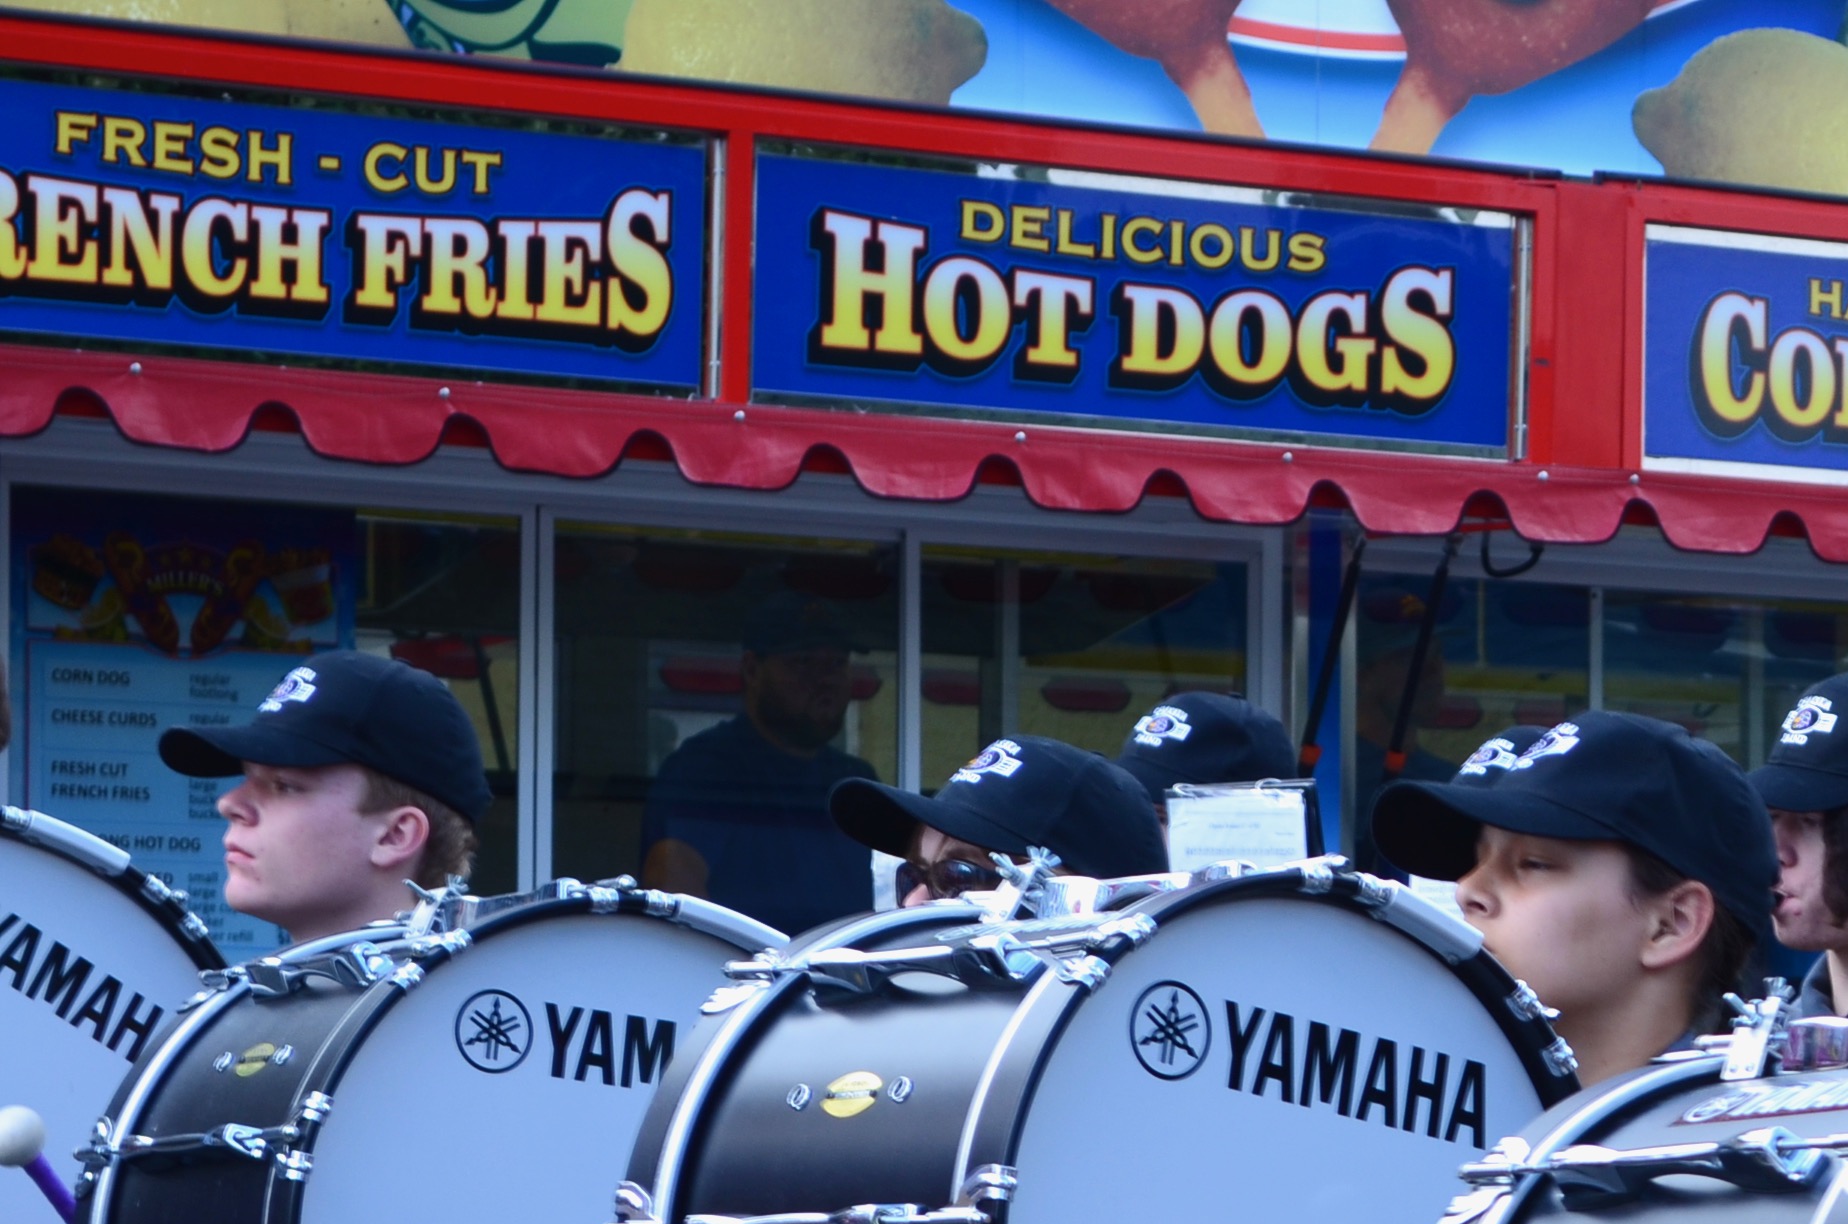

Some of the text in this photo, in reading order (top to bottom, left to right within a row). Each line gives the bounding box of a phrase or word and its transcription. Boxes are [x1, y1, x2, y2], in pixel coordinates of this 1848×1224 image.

[55, 110, 293, 185] FRESH
[363, 142, 503, 194] CUT
[355, 187, 674, 338] FRIES
[960, 200, 1326, 273] DELICIOUS
[819, 210, 1456, 400] HOT DOGS
[50, 667, 130, 687] CORN DOG
[50, 709, 157, 728] CHEESE CURDS
[50, 759, 129, 778] FRESH CUT
[50, 782, 150, 801] FRENCH FRIES
[0, 913, 164, 1064] AMAH
[545, 1001, 677, 1089] YAM
[1226, 999, 1487, 1148] YAMAHA
